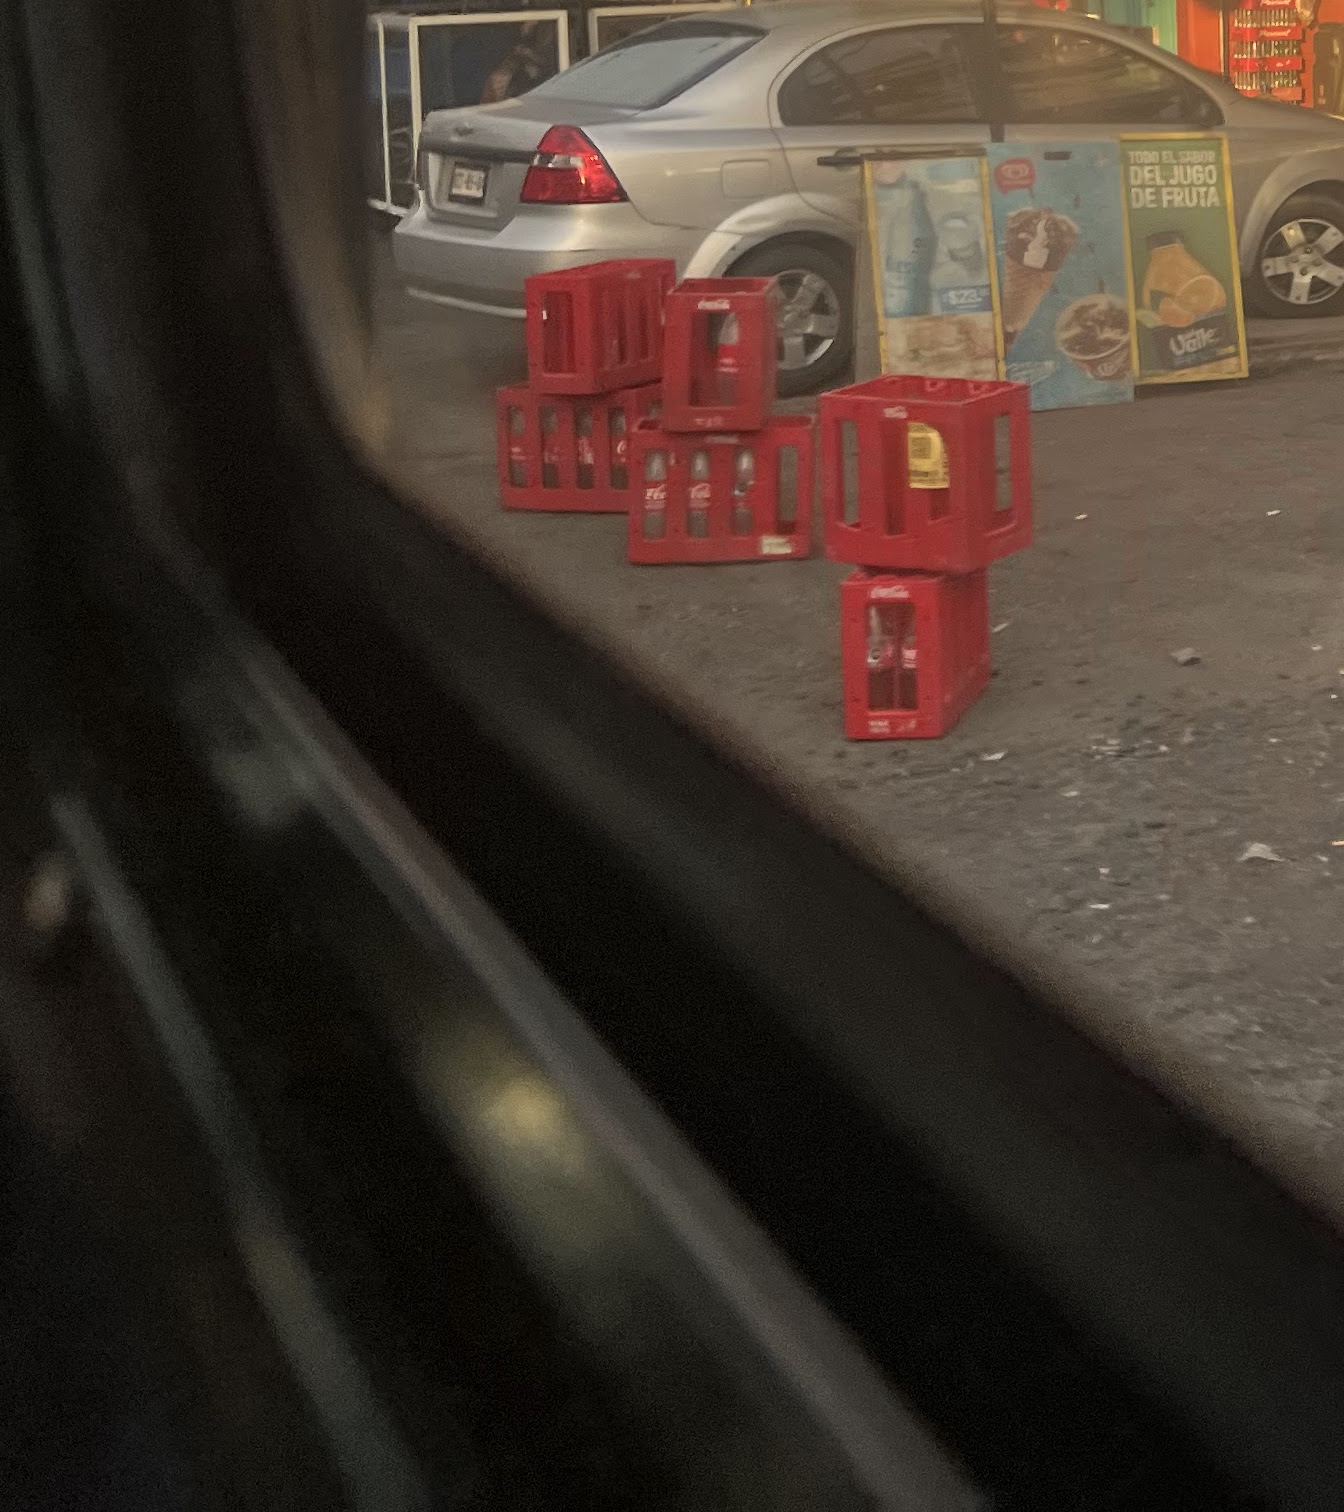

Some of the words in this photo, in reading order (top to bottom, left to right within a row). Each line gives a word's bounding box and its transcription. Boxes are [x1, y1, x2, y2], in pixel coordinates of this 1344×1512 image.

[1129, 150, 1160, 164] TODO
[1161, 150, 1177, 164] EL
[1178, 150, 1216, 164] SABOR
[1129, 165, 1167, 186] DEL
[1168, 164, 1217, 185] JUGO
[1131, 186, 1158, 208] DE
[1161, 186, 1220, 208] FRUTA
